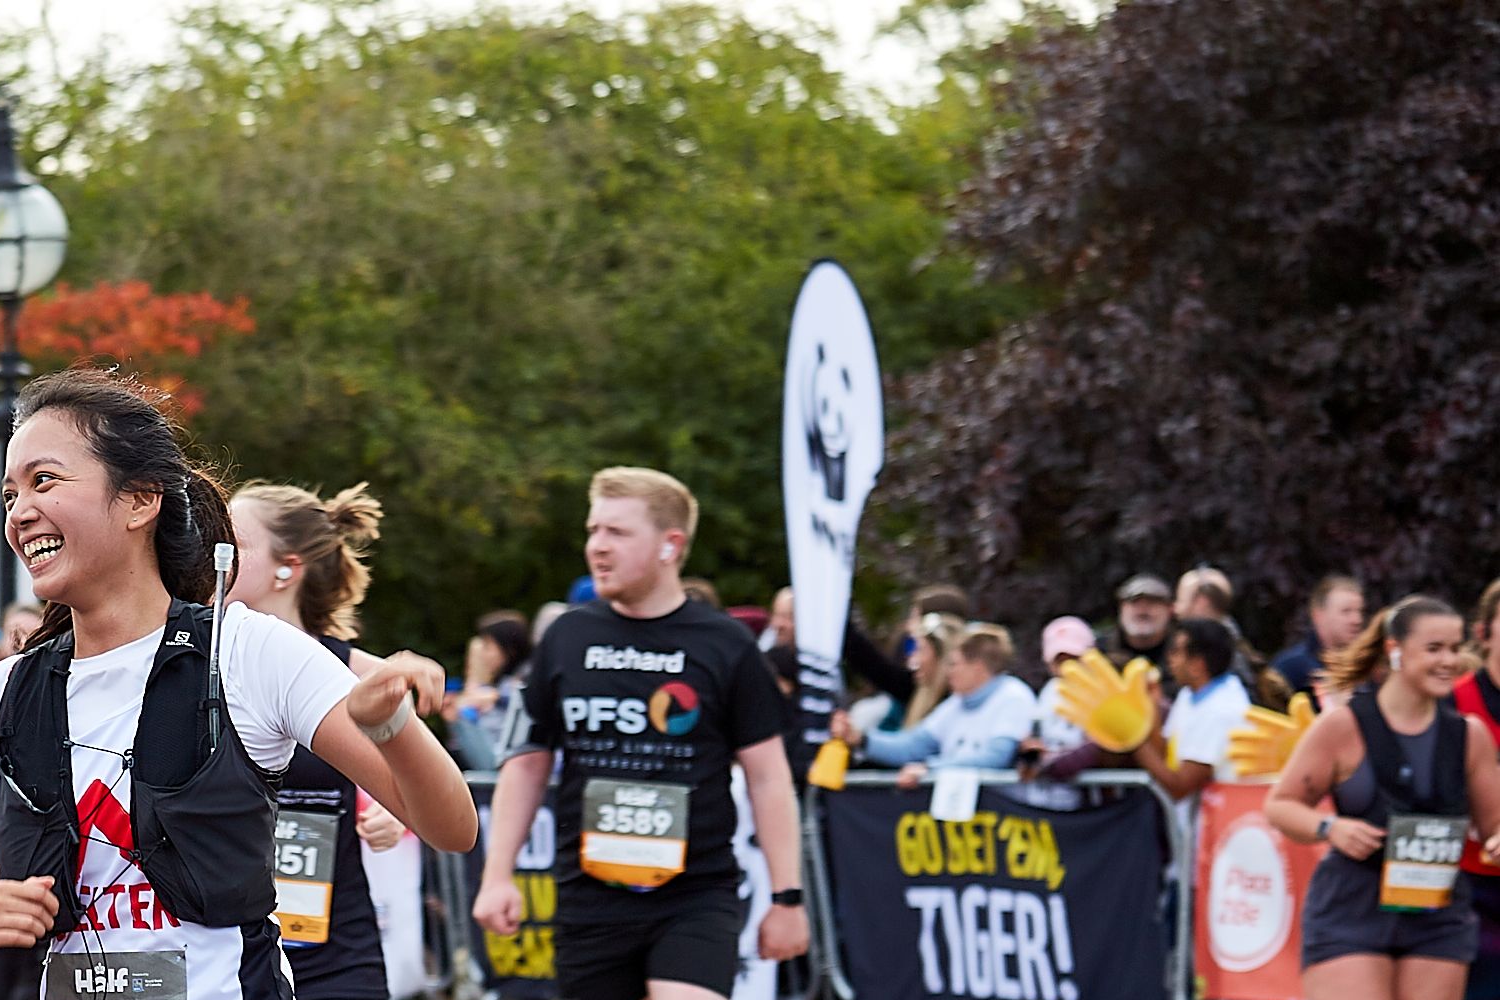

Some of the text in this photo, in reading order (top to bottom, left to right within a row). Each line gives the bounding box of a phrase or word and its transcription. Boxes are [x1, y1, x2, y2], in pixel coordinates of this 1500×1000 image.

[585, 645, 685, 673] Richard
[563, 696, 647, 734] PFS
[596, 804, 674, 836] 3589
[896, 812, 944, 876] GO
[944, 812, 998, 876] SET
[74, 967, 129, 993] Half
